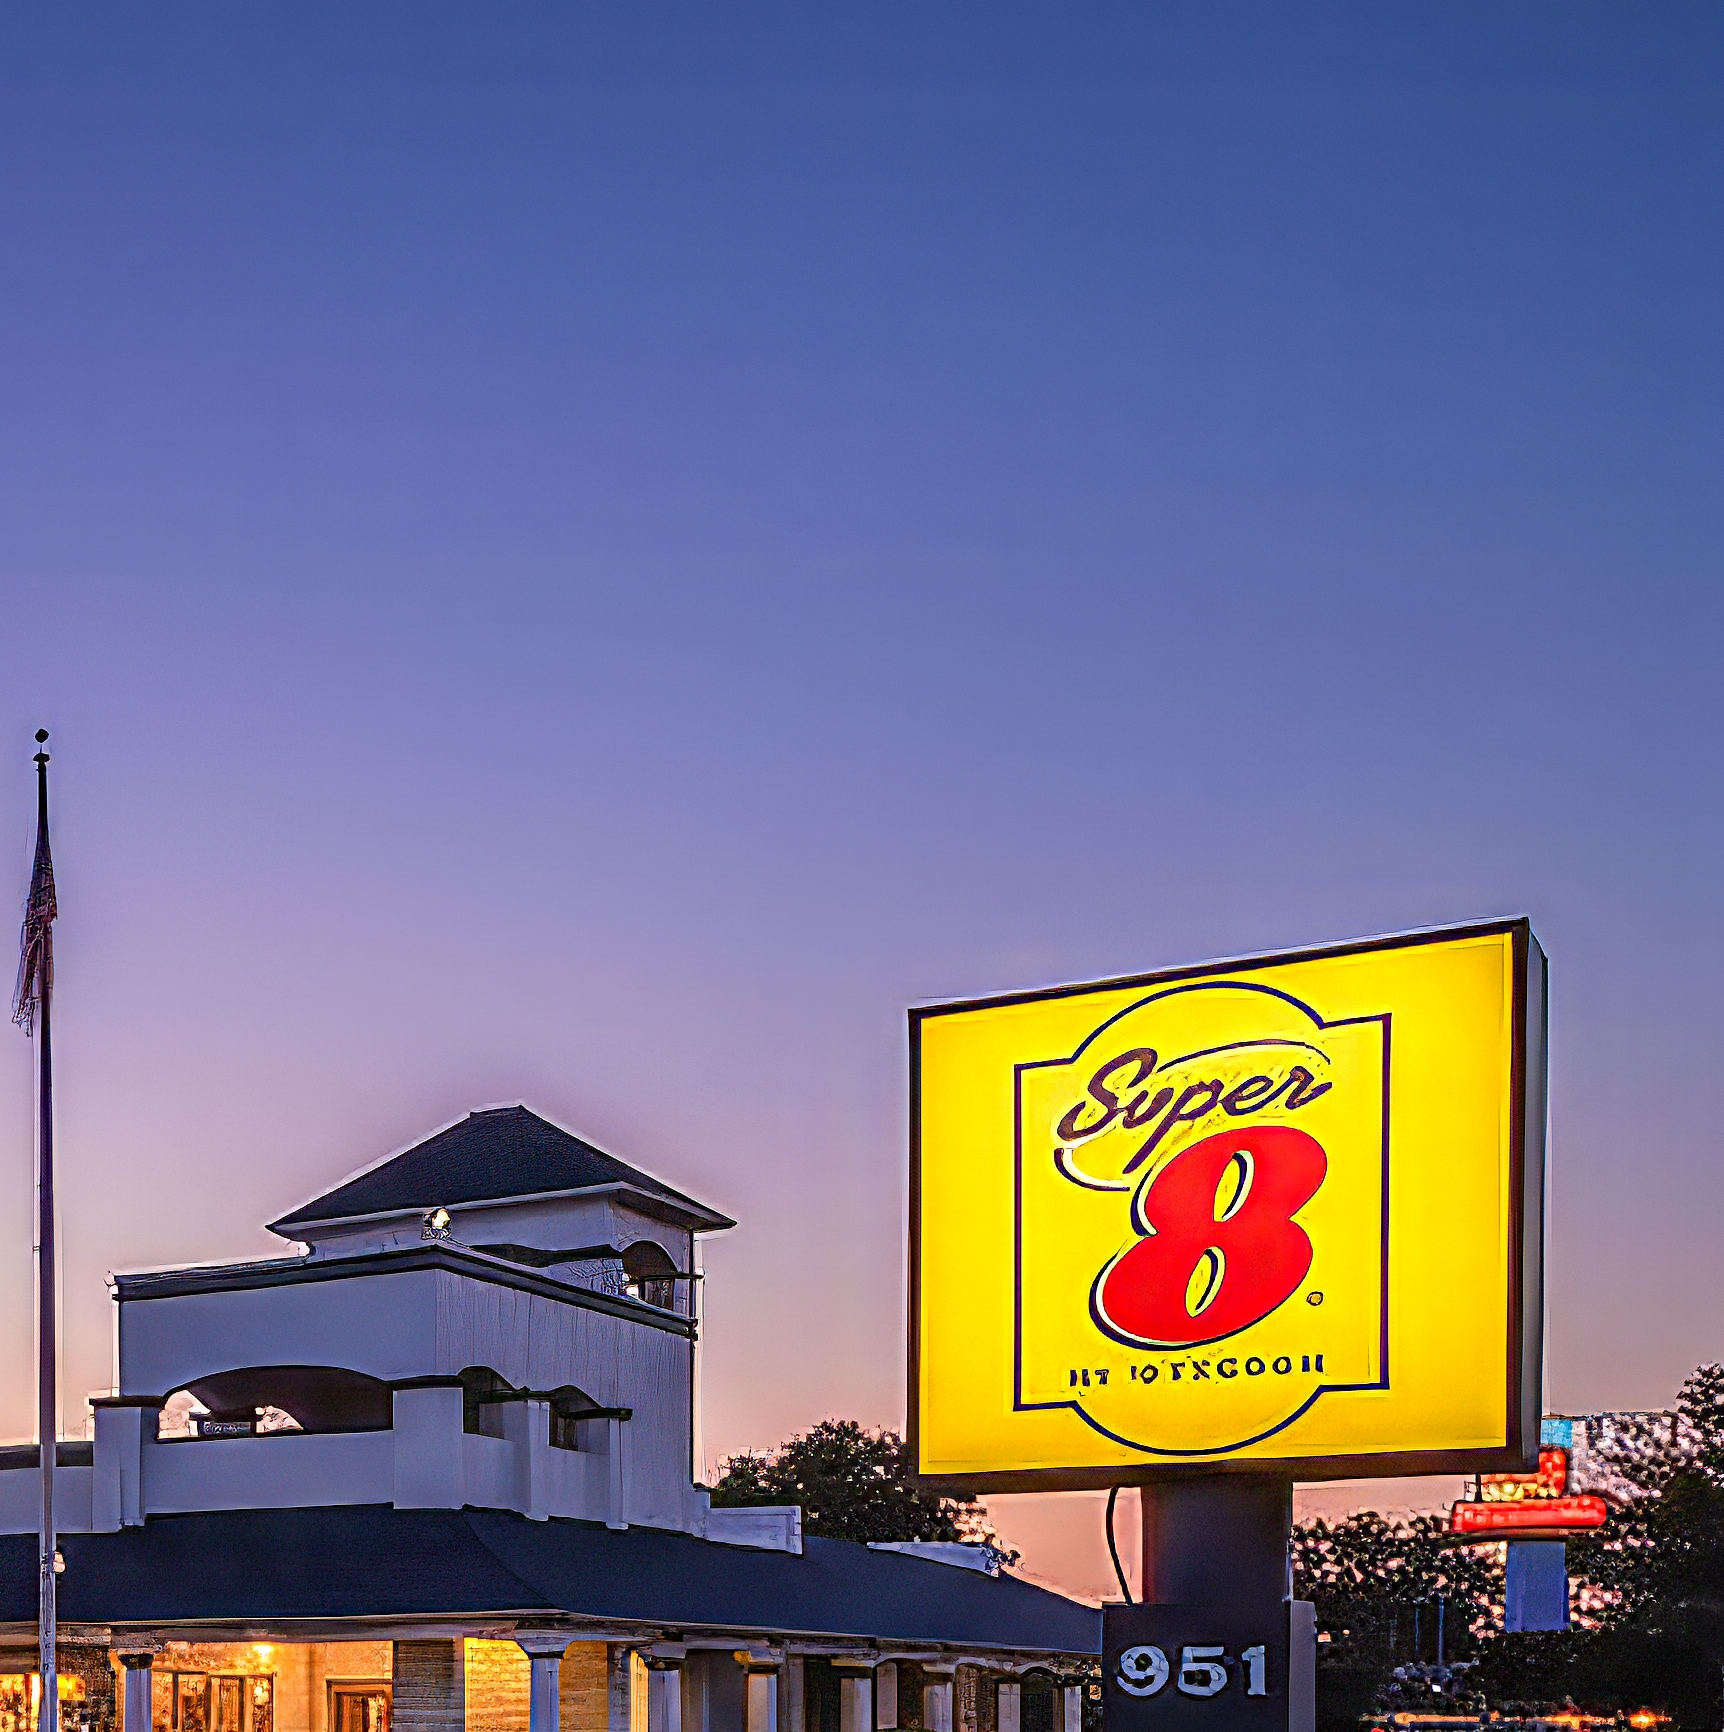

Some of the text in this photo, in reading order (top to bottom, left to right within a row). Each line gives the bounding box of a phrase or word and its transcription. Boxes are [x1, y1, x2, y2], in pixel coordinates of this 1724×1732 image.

[1055, 1047, 1333, 1175] Super
[1089, 1125, 1328, 1352] 8
[1116, 1644, 1267, 1697] 951
